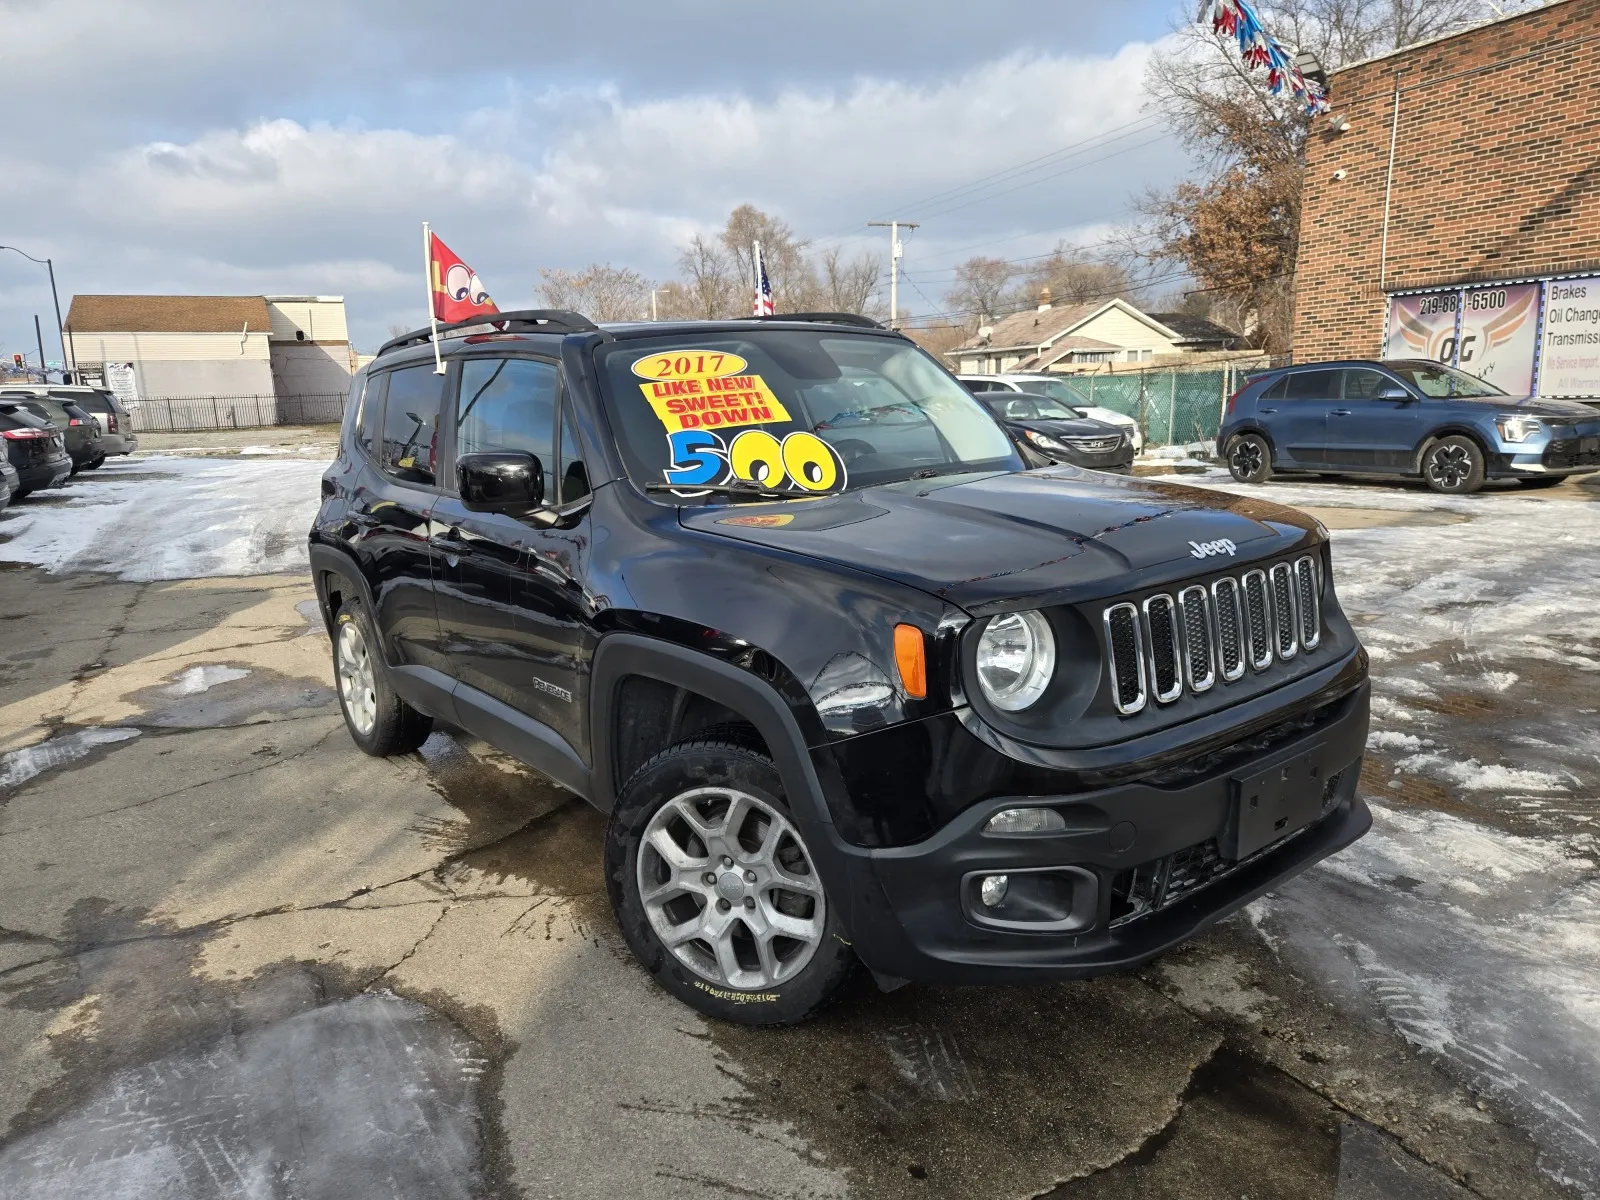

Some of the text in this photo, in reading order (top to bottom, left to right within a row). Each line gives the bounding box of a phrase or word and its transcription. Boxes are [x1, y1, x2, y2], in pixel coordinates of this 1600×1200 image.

[1420, 290, 1507, 315] 219-88-6500
[1551, 284, 1587, 300] Brakes
[1549, 308, 1563, 323] Oil
[1440, 335, 1477, 363] OG
[656, 354, 725, 378] 2017
[652, 376, 755, 398] LIKE NEW
[666, 391, 764, 414] SWEET!
[679, 406, 773, 429] DOWN
[663, 430, 847, 497] 500
[1188, 538, 1236, 559] Jeep
